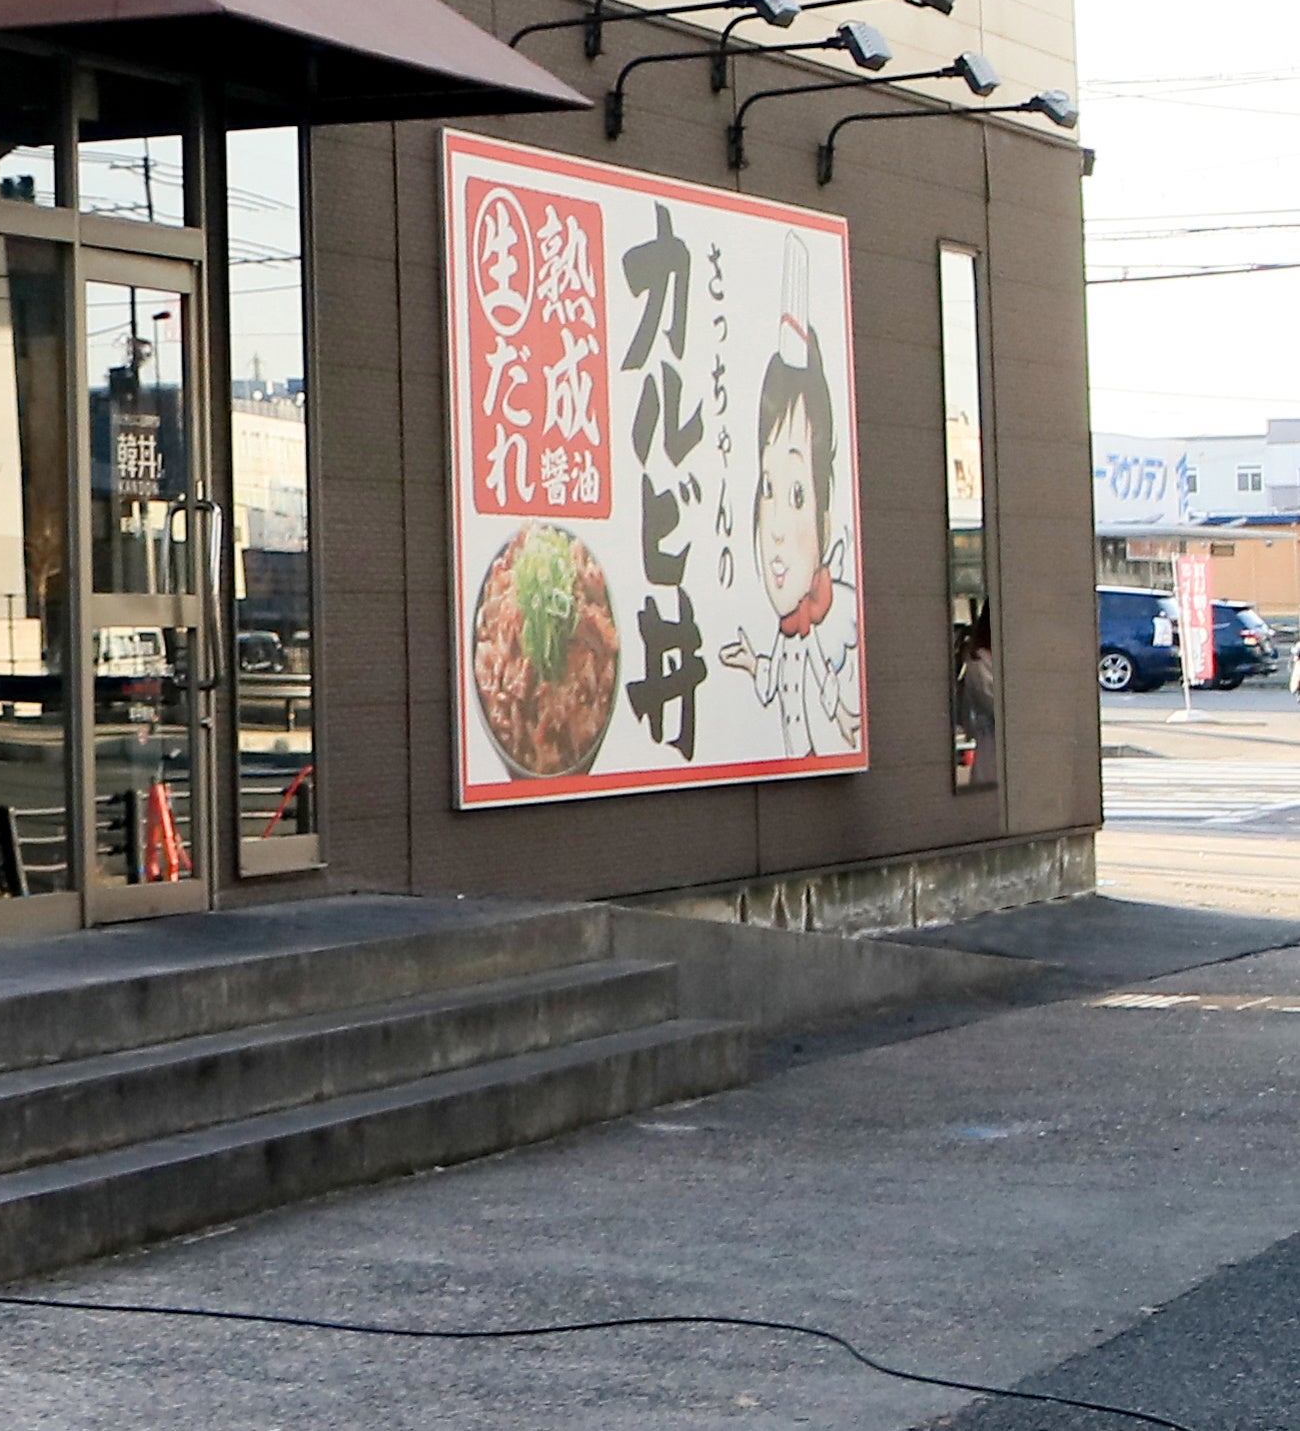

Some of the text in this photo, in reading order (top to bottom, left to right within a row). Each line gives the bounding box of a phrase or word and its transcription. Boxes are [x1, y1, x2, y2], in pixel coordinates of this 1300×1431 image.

[621, 200, 707, 762] カルビ丼
[707, 241, 737, 591] さっちゃんの
